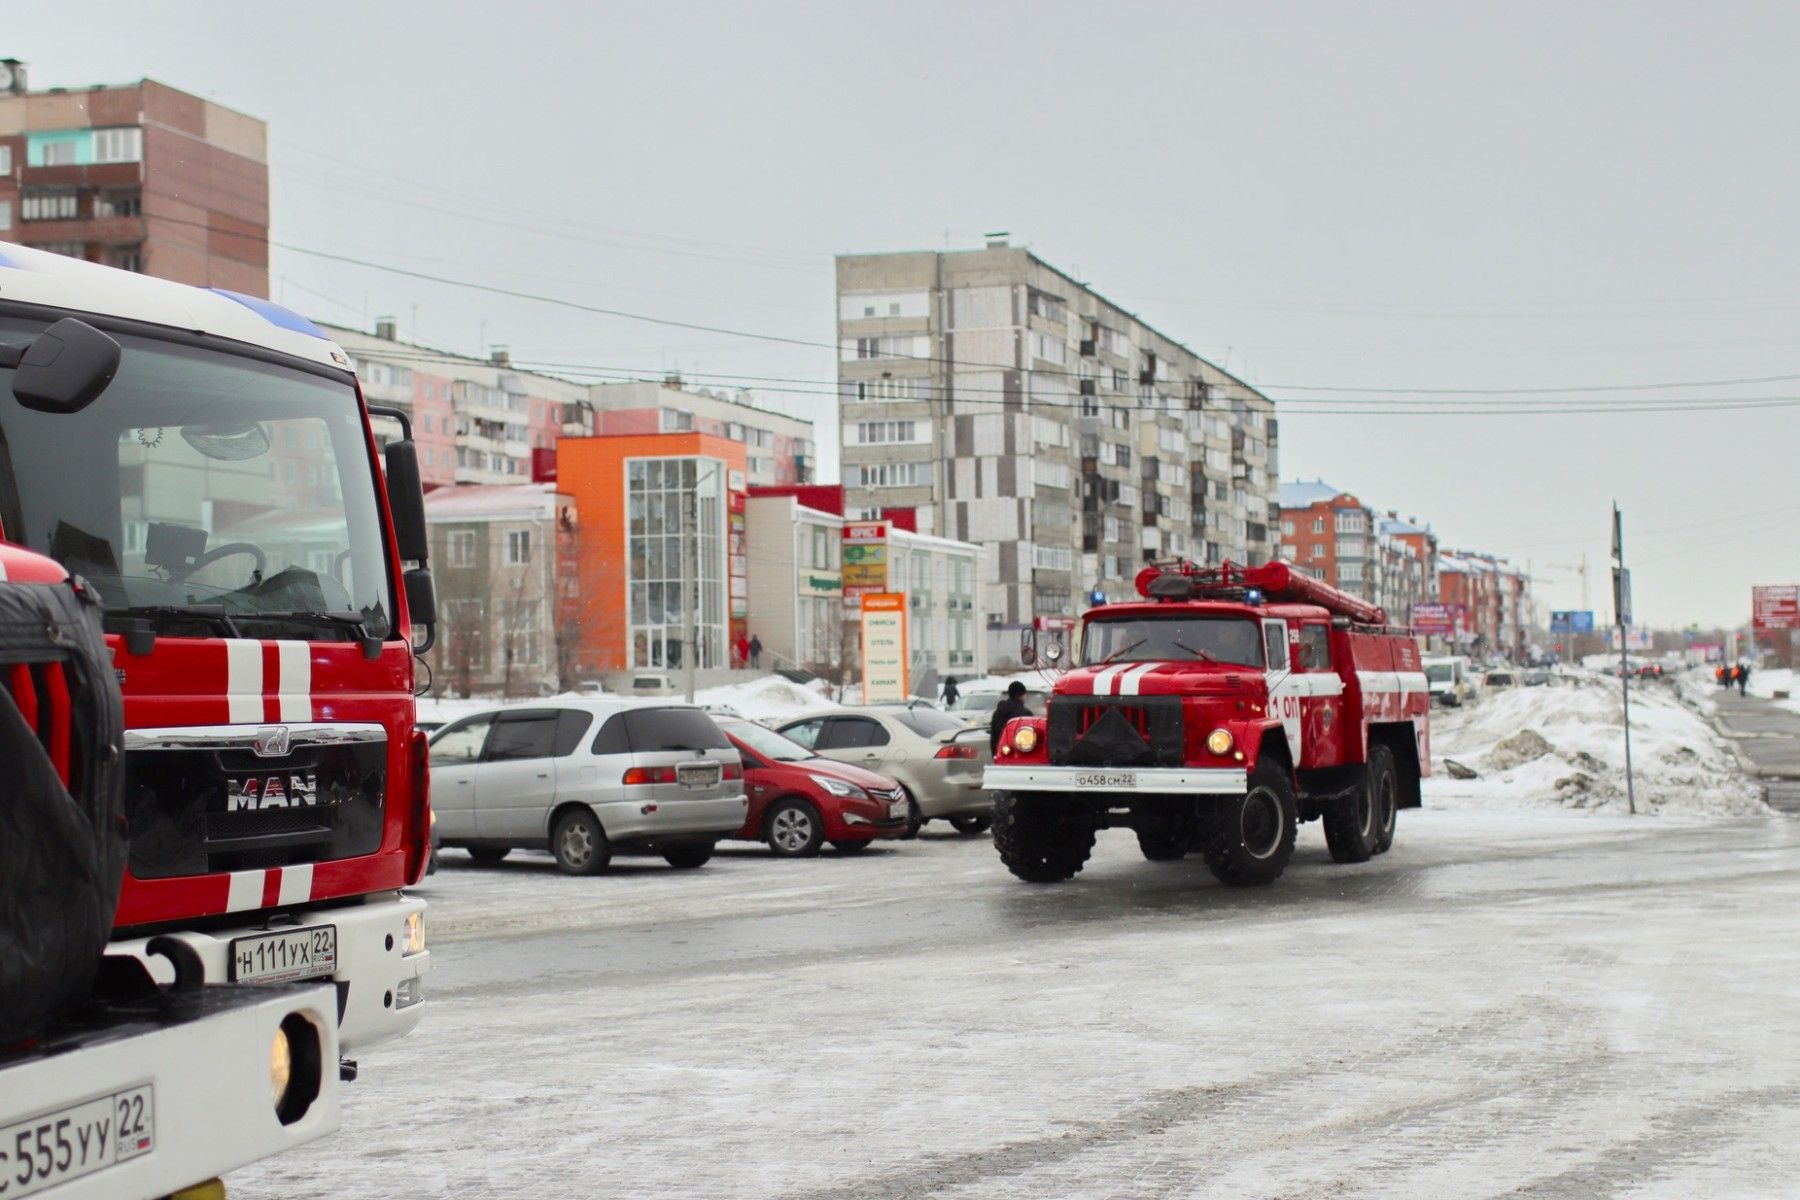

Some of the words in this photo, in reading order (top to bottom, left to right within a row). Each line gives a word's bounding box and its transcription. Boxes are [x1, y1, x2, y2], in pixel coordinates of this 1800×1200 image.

[227, 774, 317, 812] MAN
[313, 931, 329, 954] 22
[118, 1094, 145, 1138] 22
